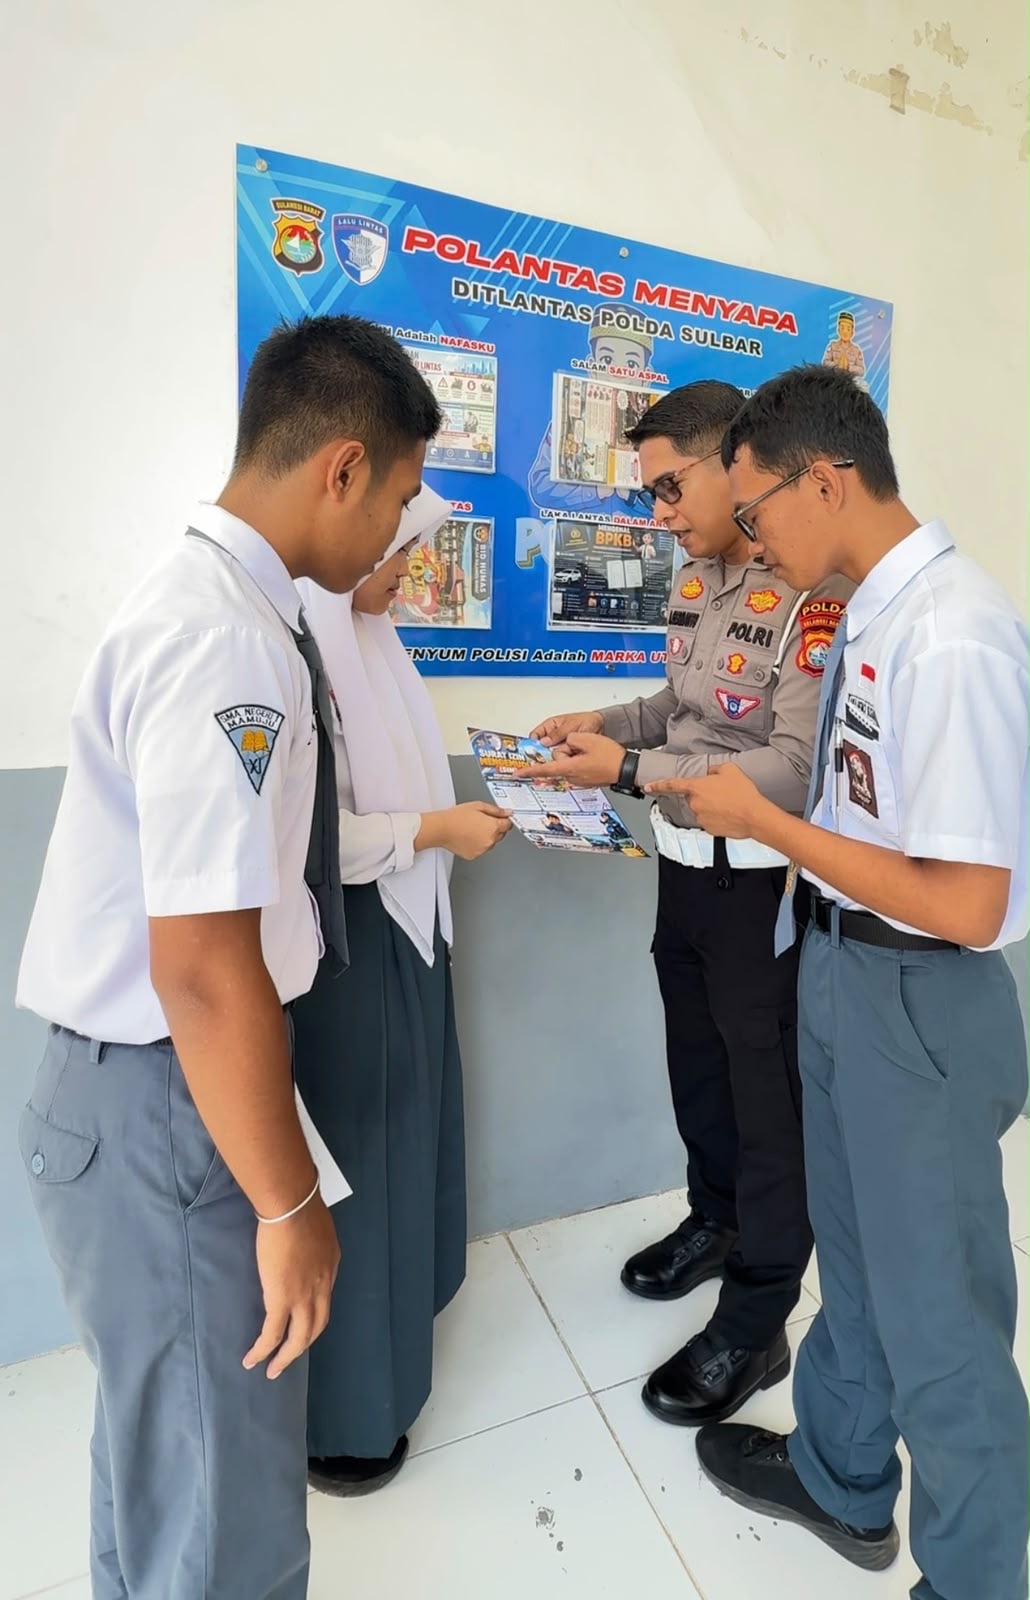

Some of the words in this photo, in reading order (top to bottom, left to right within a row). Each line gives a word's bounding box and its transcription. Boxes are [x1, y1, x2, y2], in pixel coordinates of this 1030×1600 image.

[358, 219, 384, 234] LINTAS
[404, 228, 625, 295] POLANTAS
[634, 281, 798, 334] MENYAPA
[452, 279, 593, 323] DITLANTAS
[600, 309, 674, 340] POLDA
[680, 326, 763, 356] SULBAR
[395, 328, 437, 343] Adalah
[440, 336, 495, 353] NAFASKU
[571, 359, 607, 372] SALAM
[609, 366, 635, 377] SATU
[638, 371, 669, 383] ASPAL
[613, 517, 647, 526] DALAM
[595, 531, 632, 548] BPKB
[479, 561, 487, 593] HUMAS
[802, 602, 848, 616] POLDA
[726, 621, 774, 648] POLRI
[471, 649, 527, 661] POLISI
[532, 650, 587, 662] Adalah
[590, 651, 646, 663] MARKA
[219, 709, 241, 723] SMA
[244, 707, 274, 720] NEGERI
[226, 716, 276, 729] MAMUJU
